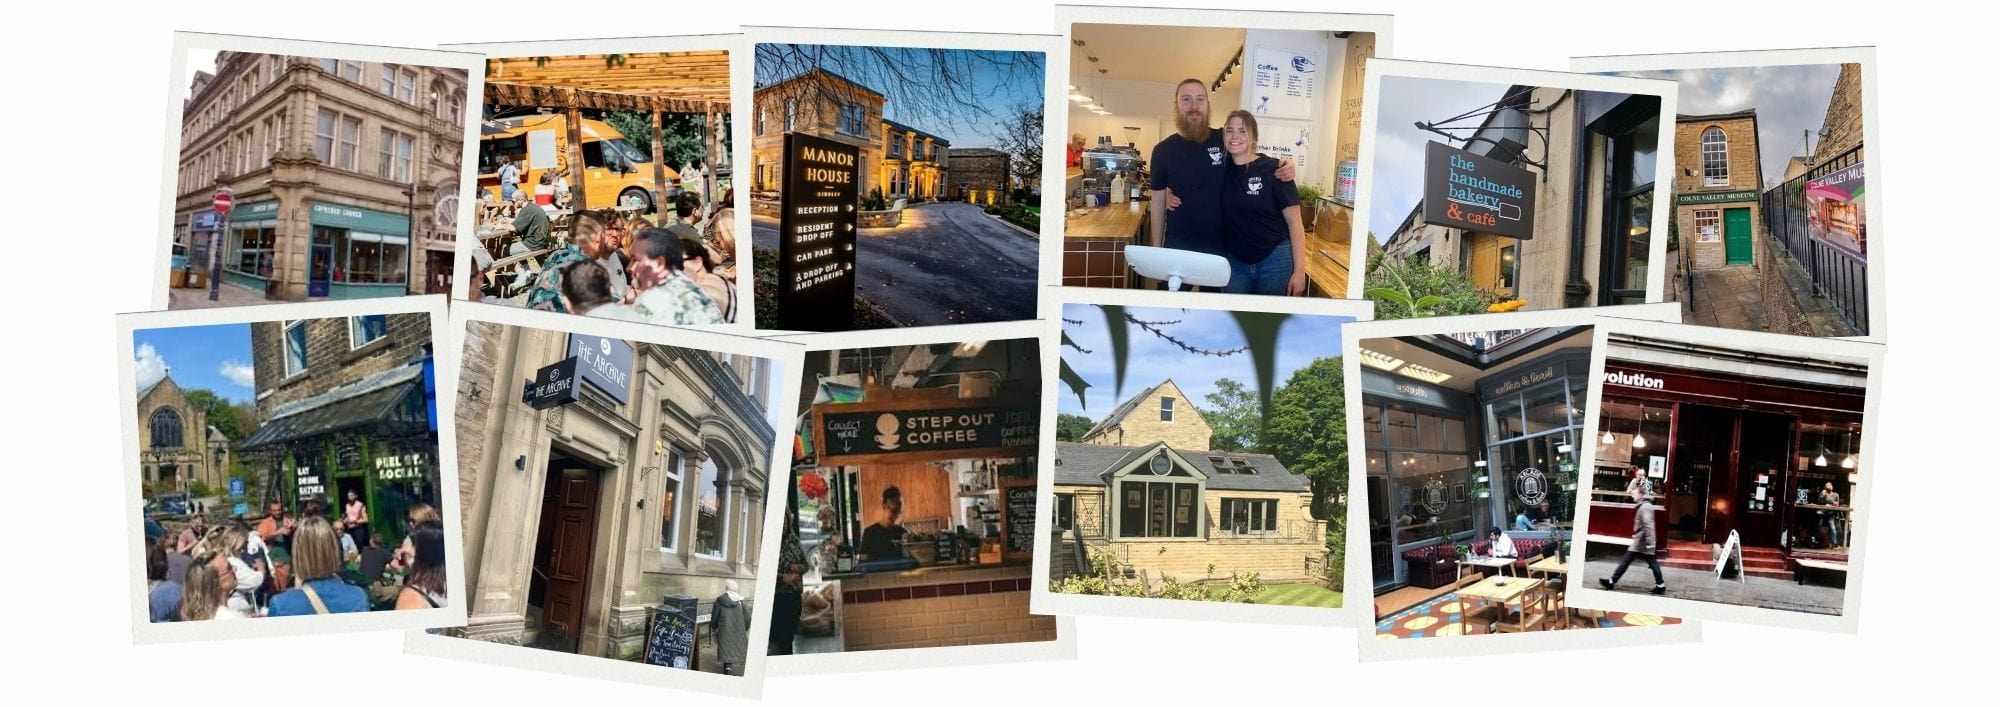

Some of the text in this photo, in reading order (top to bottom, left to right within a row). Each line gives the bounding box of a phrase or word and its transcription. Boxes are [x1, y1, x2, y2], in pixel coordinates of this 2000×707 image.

[803, 146, 854, 167] MANOR
[1450, 154, 1475, 172] the
[807, 167, 851, 184] HOUSE
[1448, 168, 1523, 199] handmade
[1824, 173, 1847, 185] VALLEY
[1448, 183, 1500, 211] bakery
[1680, 194, 1700, 202] COLNE
[798, 205, 839, 215] RECEPTION
[1447, 203, 1496, 226] & café
[797, 222, 834, 234] RESIDENT
[797, 231, 834, 243] DROP OFF
[796, 248, 833, 262] CAR PARK
[803, 263, 839, 279] DROP OFF
[795, 269, 844, 291] AND PARKING
[577, 340, 626, 388] THE ARCHIVE
[535, 377, 572, 398] THE ARCHIVE
[828, 420, 861, 431] COLLECT
[906, 415, 953, 430] STEP
[958, 413, 995, 427] OUT
[837, 430, 858, 439] HERE
[907, 430, 977, 445] COFFEE
